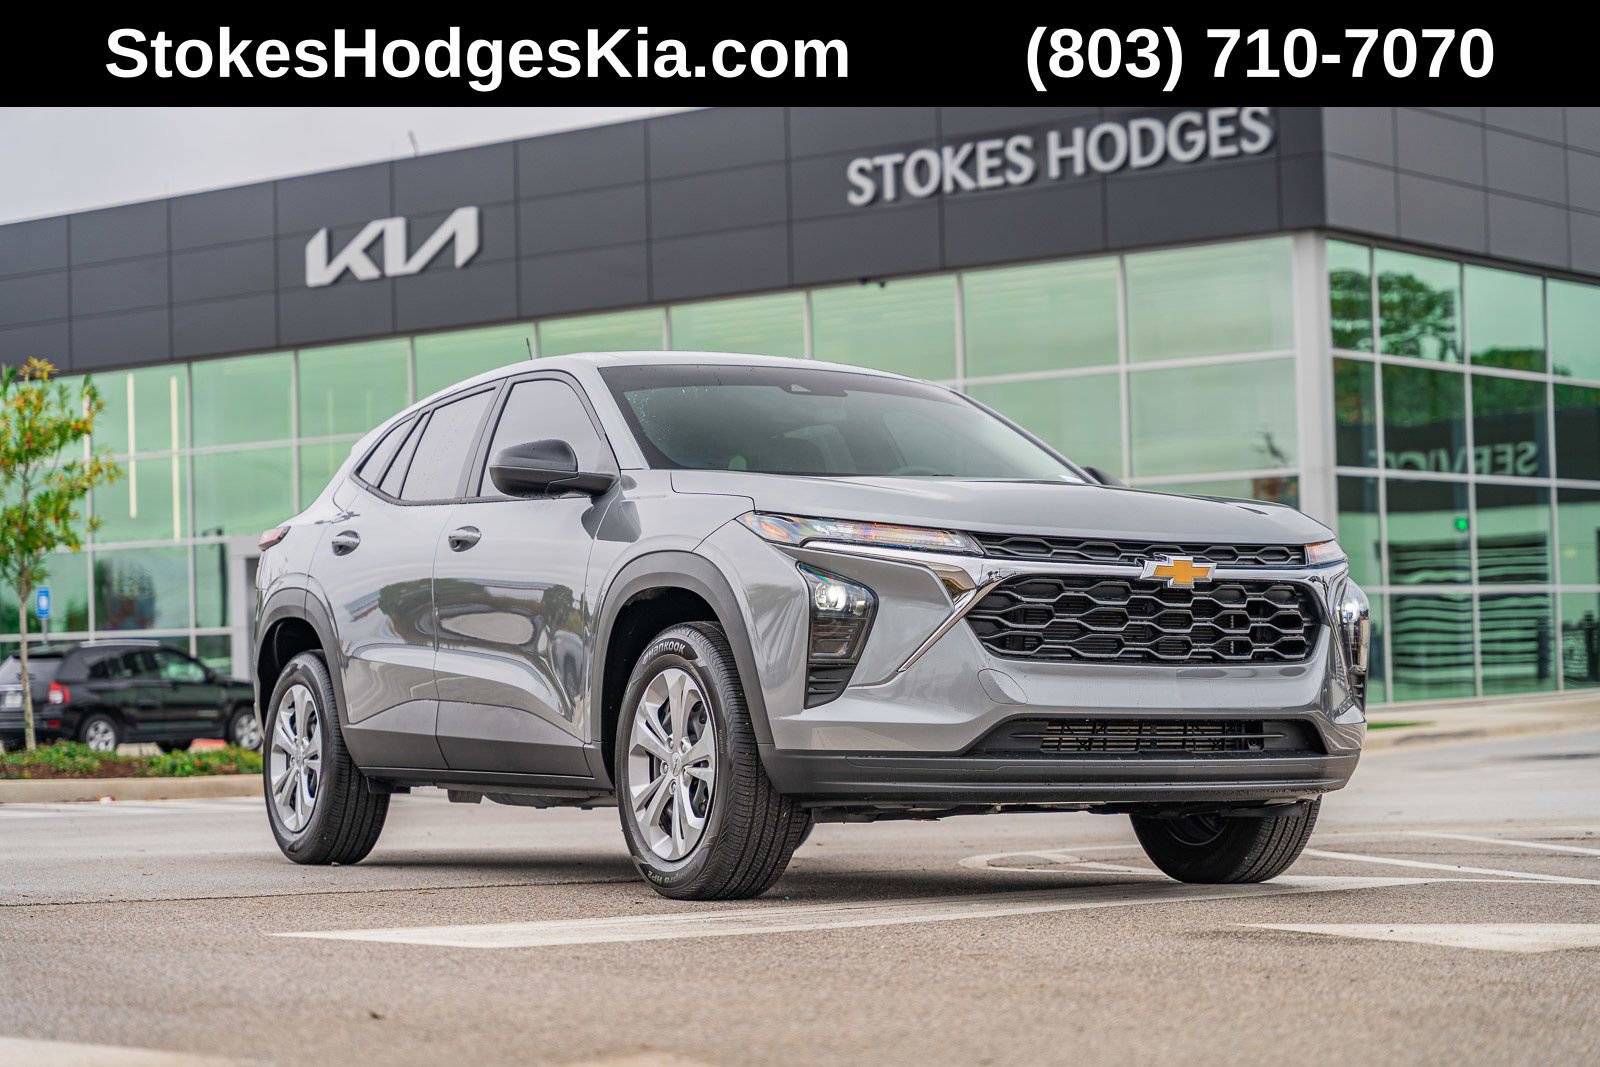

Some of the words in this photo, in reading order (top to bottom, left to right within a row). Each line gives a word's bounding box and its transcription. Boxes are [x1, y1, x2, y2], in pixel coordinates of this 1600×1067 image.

[847, 135, 1037, 206] STOKES
[1047, 107, 1273, 179] HODGES
[305, 206, 481, 288] KIA
